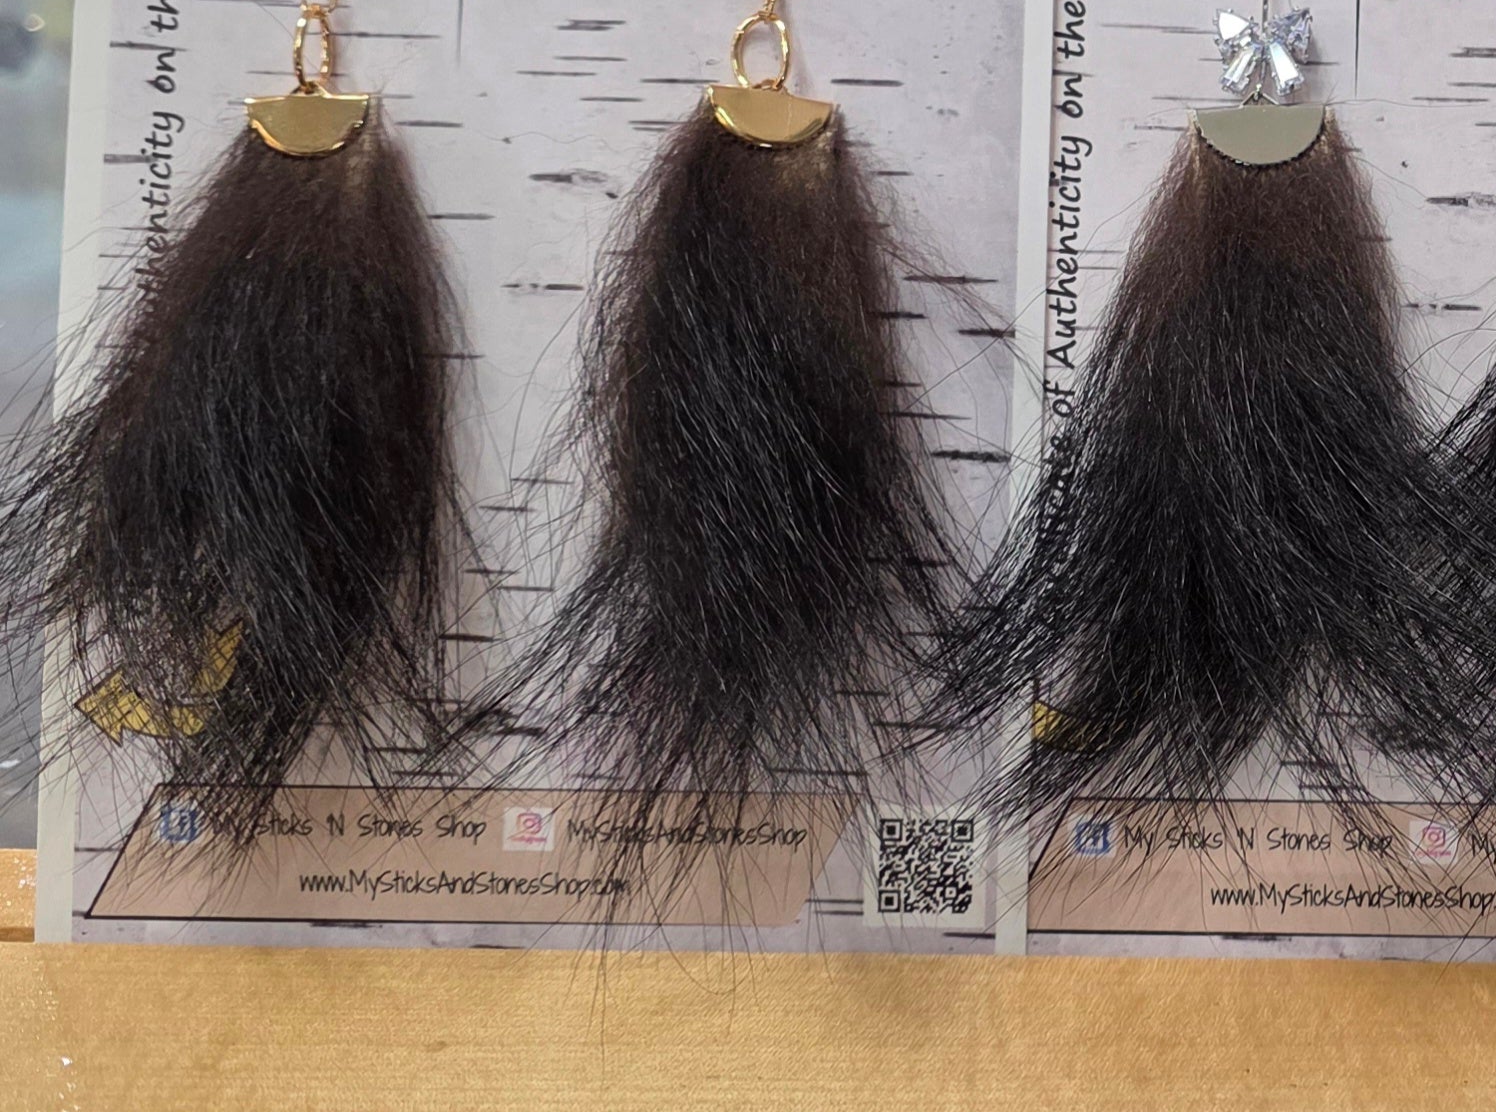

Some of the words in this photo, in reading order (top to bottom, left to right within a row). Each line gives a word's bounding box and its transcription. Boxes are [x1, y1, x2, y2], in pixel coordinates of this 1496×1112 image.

[1053, 0, 1086, 61] the
[150, 47, 176, 93] on
[1056, 73, 1083, 118] on
[1047, 135, 1093, 370] Authenticity
[1043, 379, 1076, 418] of
[357, 813, 423, 837] Stones
[436, 813, 487, 845] Shop
[1123, 825, 1157, 855] My
[1166, 827, 1223, 850] Sticks
[1268, 827, 1331, 851] Stones
[1344, 828, 1393, 858] Shop
